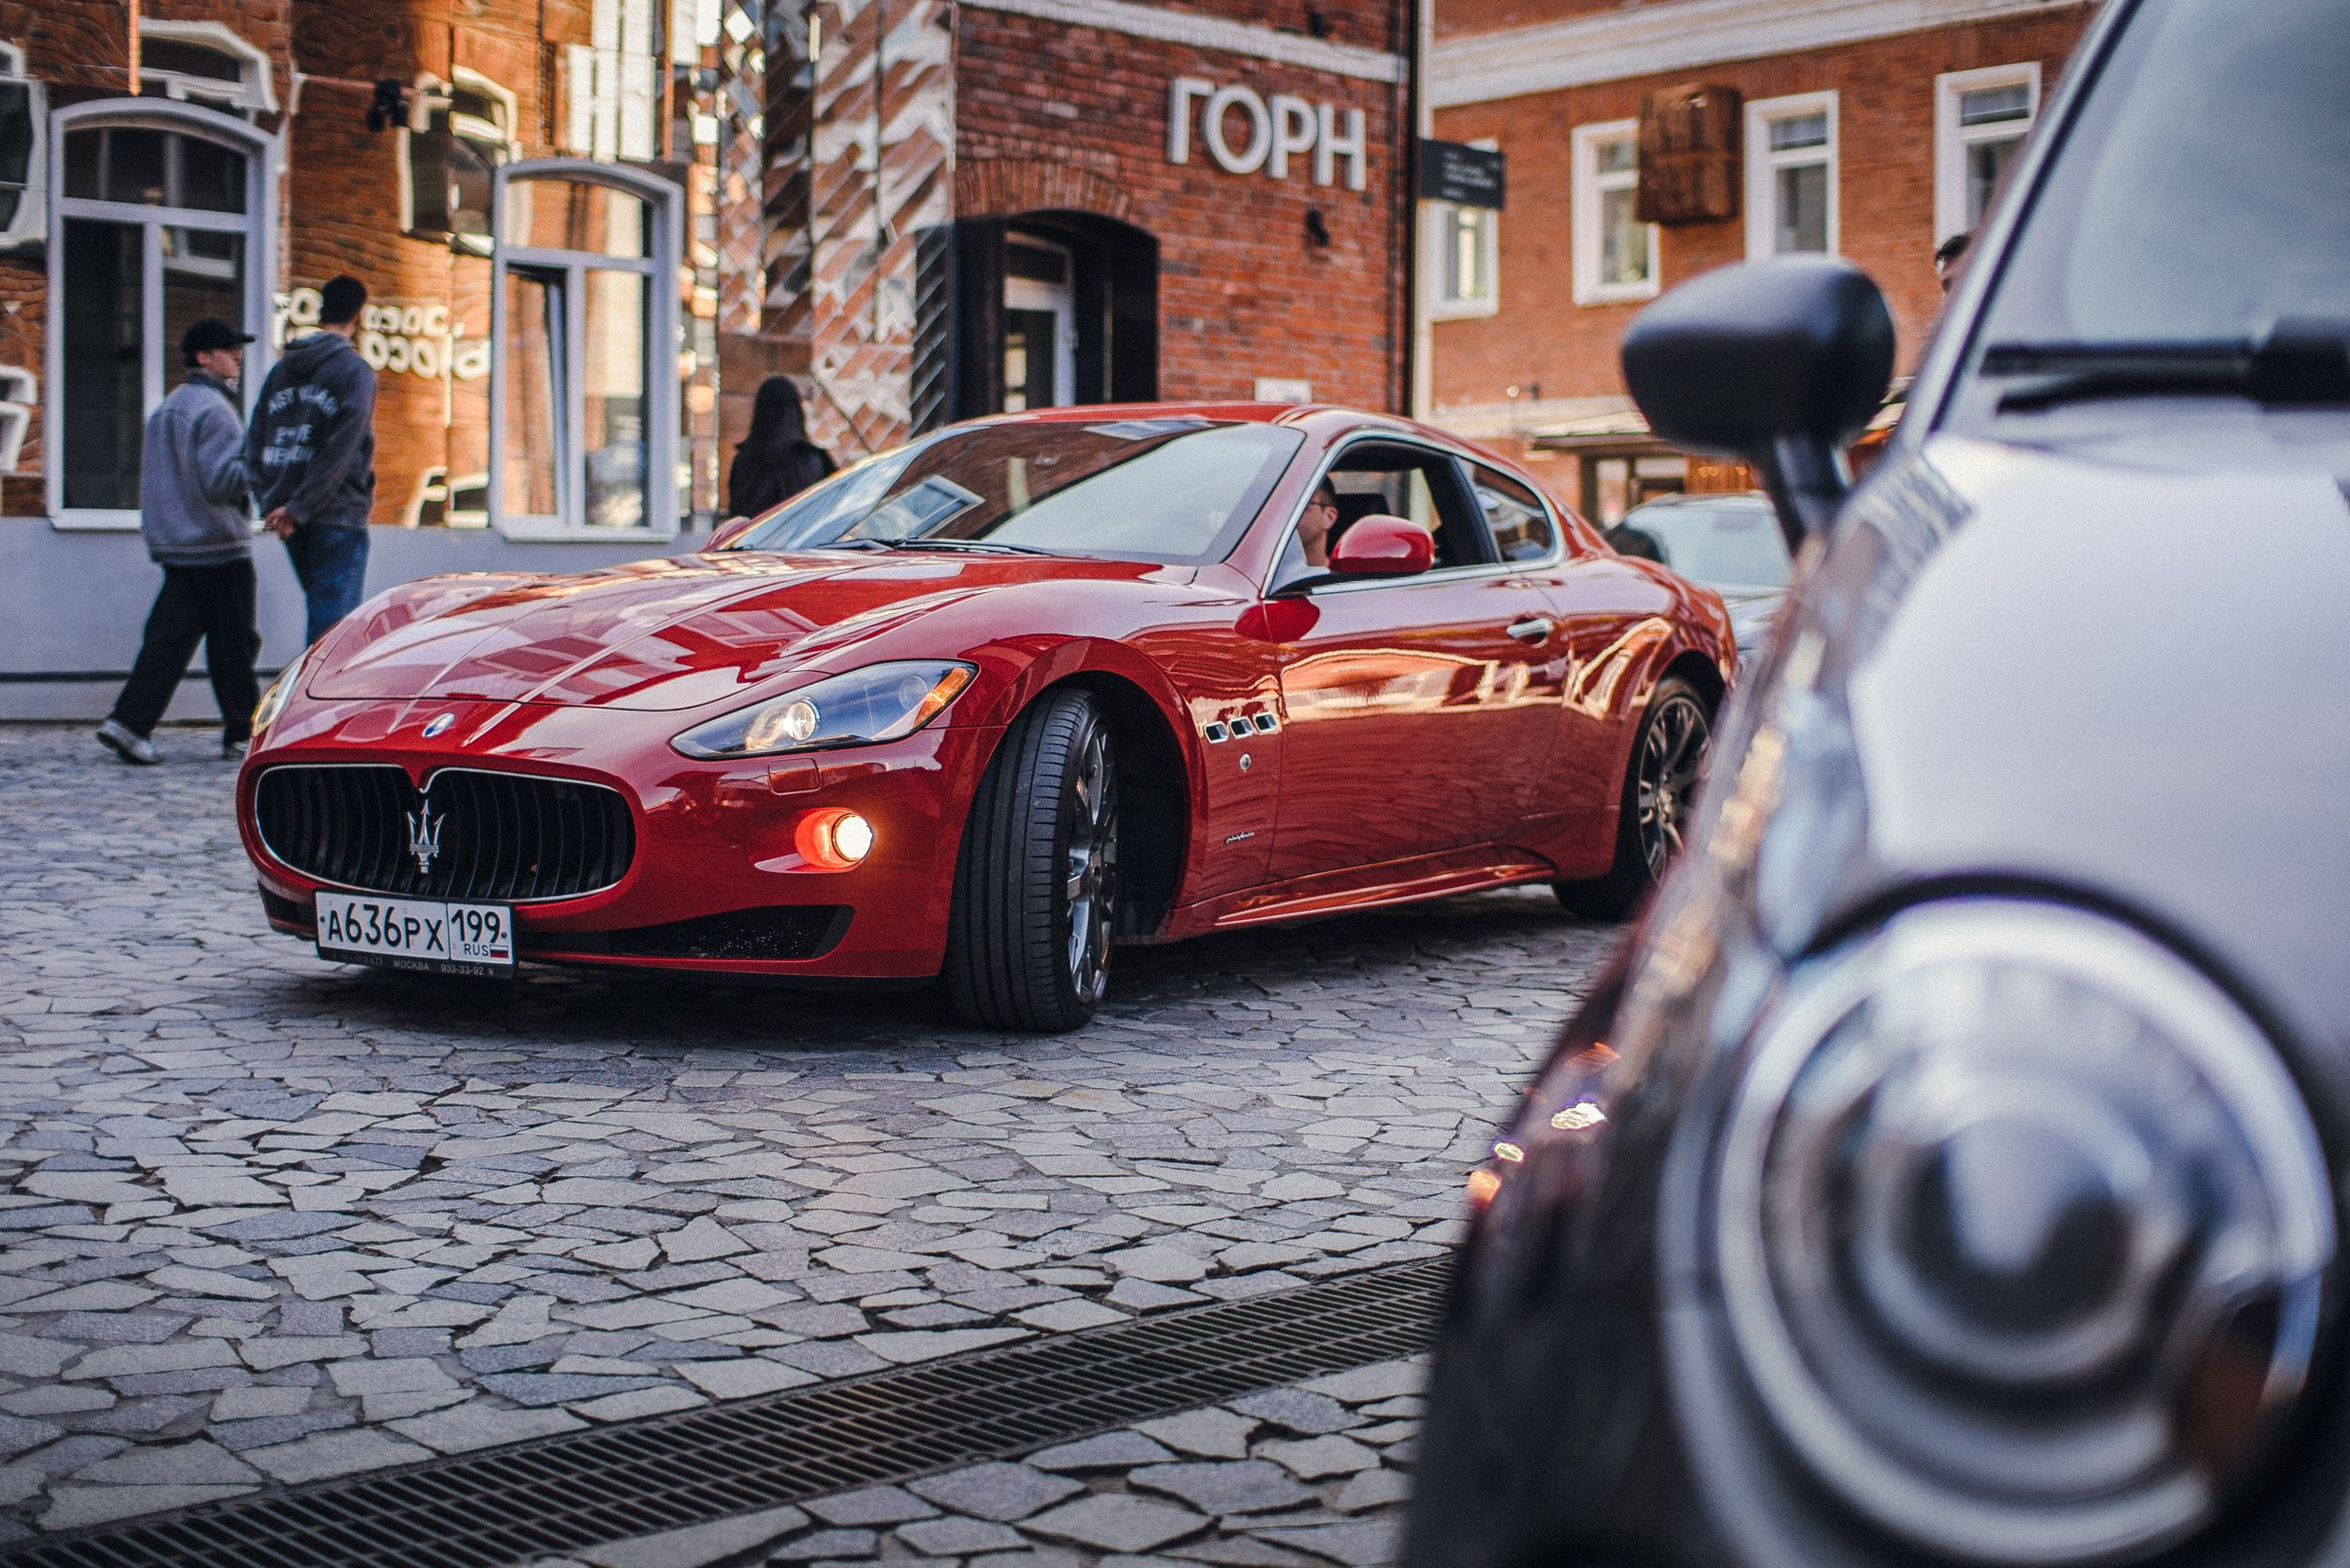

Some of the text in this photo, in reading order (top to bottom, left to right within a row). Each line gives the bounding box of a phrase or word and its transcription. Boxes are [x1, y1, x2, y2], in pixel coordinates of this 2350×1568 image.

[1166, 77, 1367, 191] ГОРН
[451, 909, 501, 944] 199
[464, 943, 489, 957] RUS
[394, 958, 431, 971] МОСКВА
